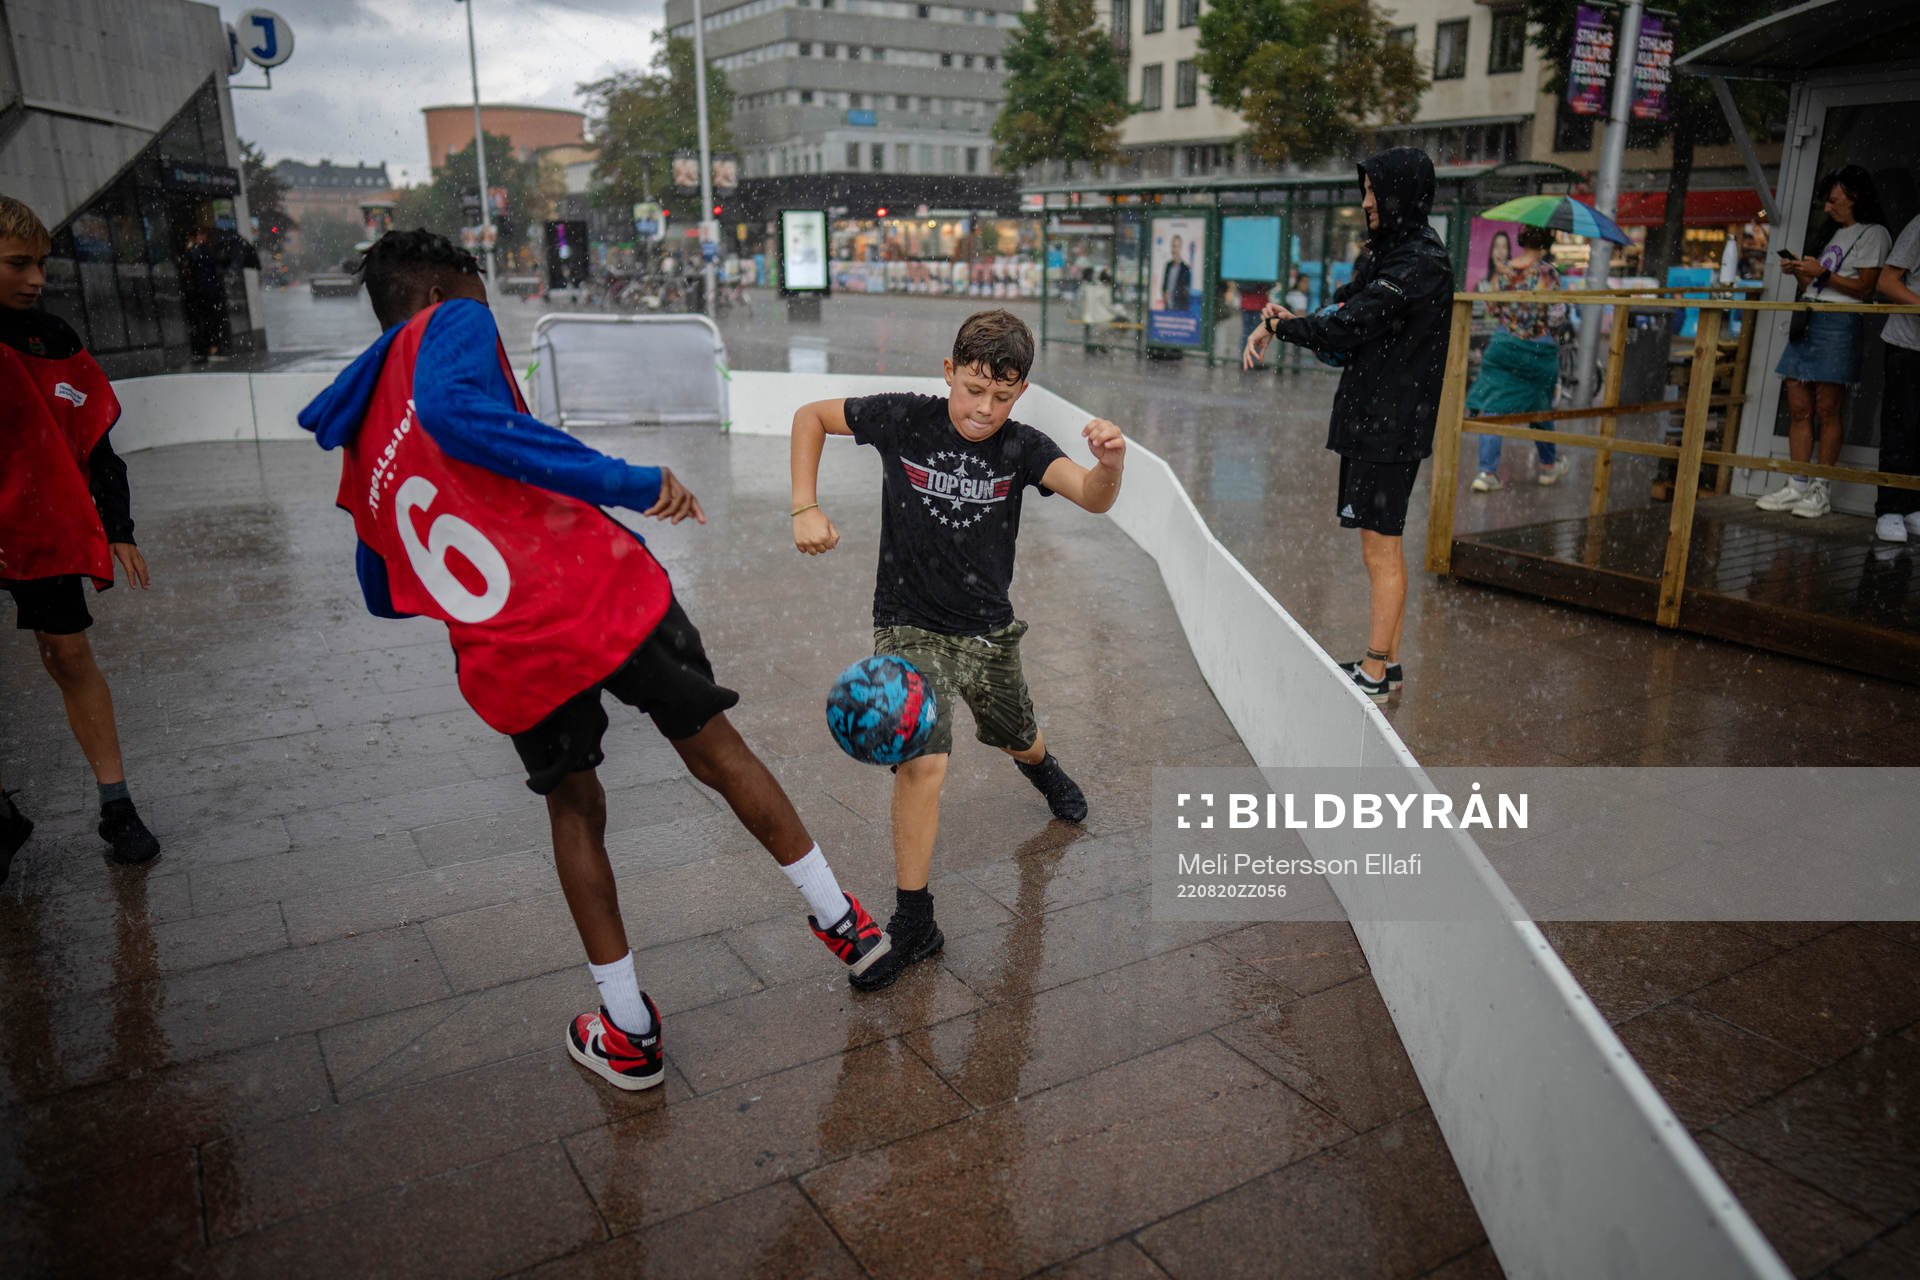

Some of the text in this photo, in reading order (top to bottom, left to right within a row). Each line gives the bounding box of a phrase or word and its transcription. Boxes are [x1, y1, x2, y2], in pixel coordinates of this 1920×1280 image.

[251, 15, 277, 59] J
[1574, 44, 1611, 61] KULTUR
[1571, 59, 1611, 77] FESTIVAL
[1633, 65, 1672, 83] FESTIVAL
[927, 469, 995, 499] TOP GUN
[395, 476, 511, 623] 6
[835, 919, 853, 936] NIKE
[641, 1035, 657, 1047] NIKE
